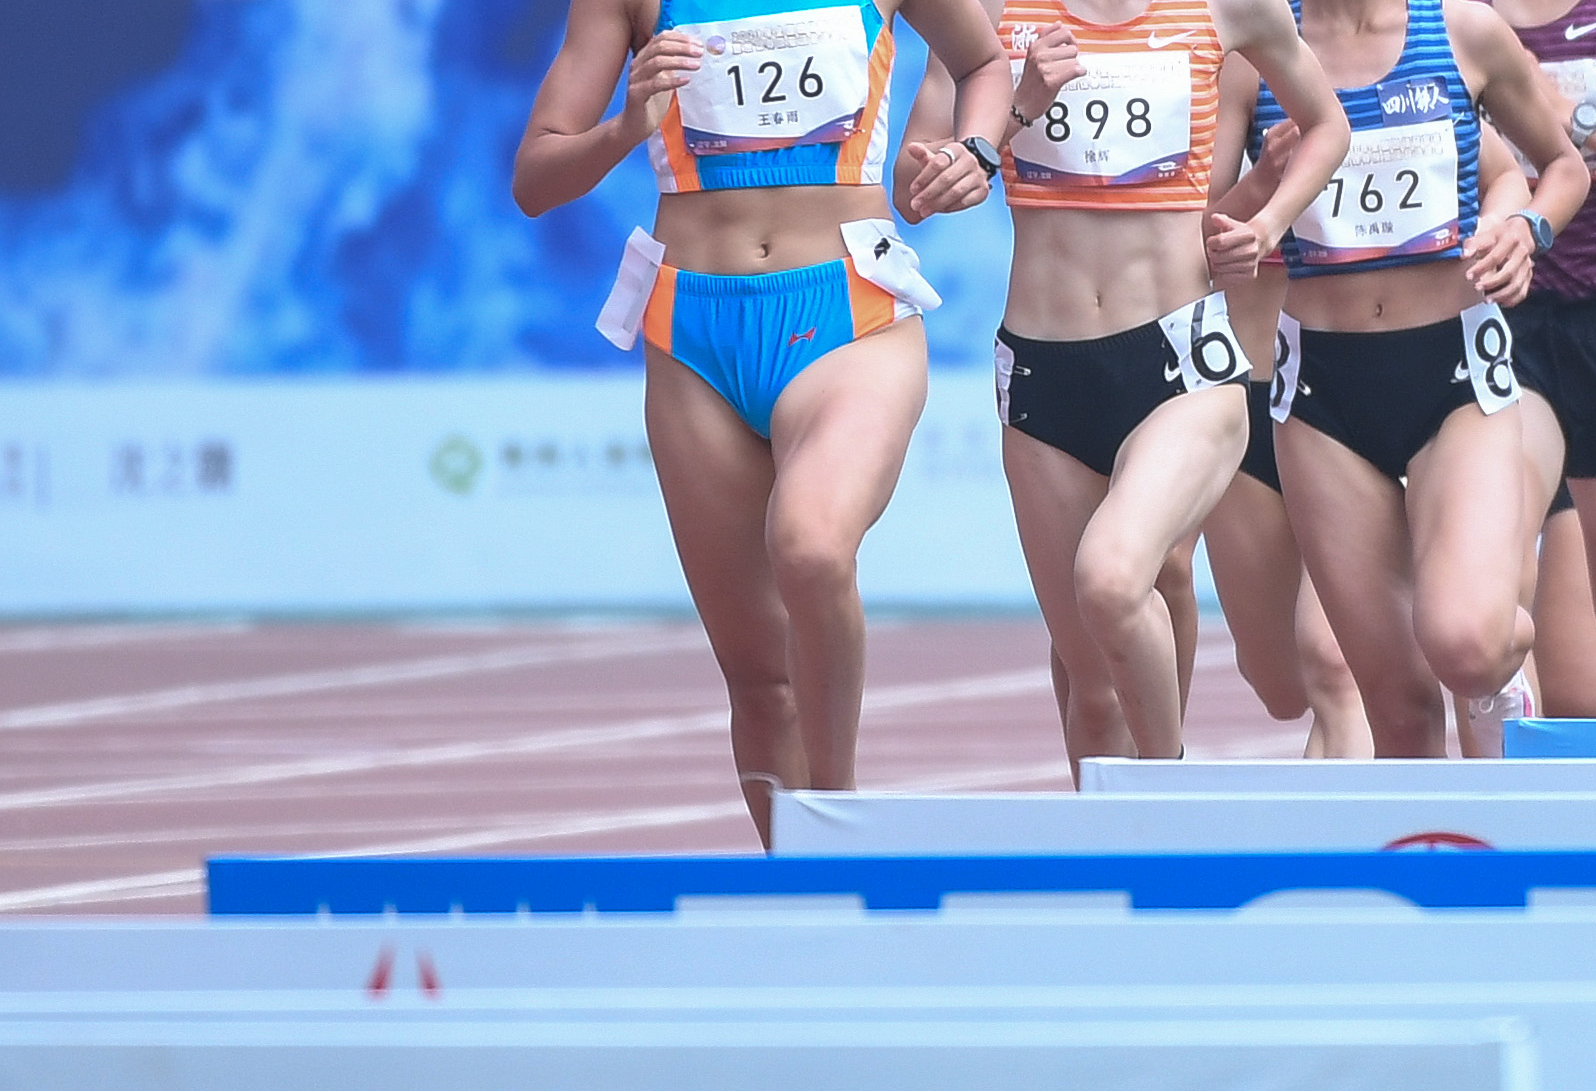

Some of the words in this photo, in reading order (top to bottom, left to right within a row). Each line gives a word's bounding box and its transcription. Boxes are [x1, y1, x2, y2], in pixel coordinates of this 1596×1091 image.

[727, 56, 824, 106] 126
[757, 110, 800, 126] 王春雨
[1045, 97, 1152, 143] 898
[1325, 169, 1423, 218] 762
[1190, 299, 1237, 382] 6
[1475, 317, 1514, 398] 8
